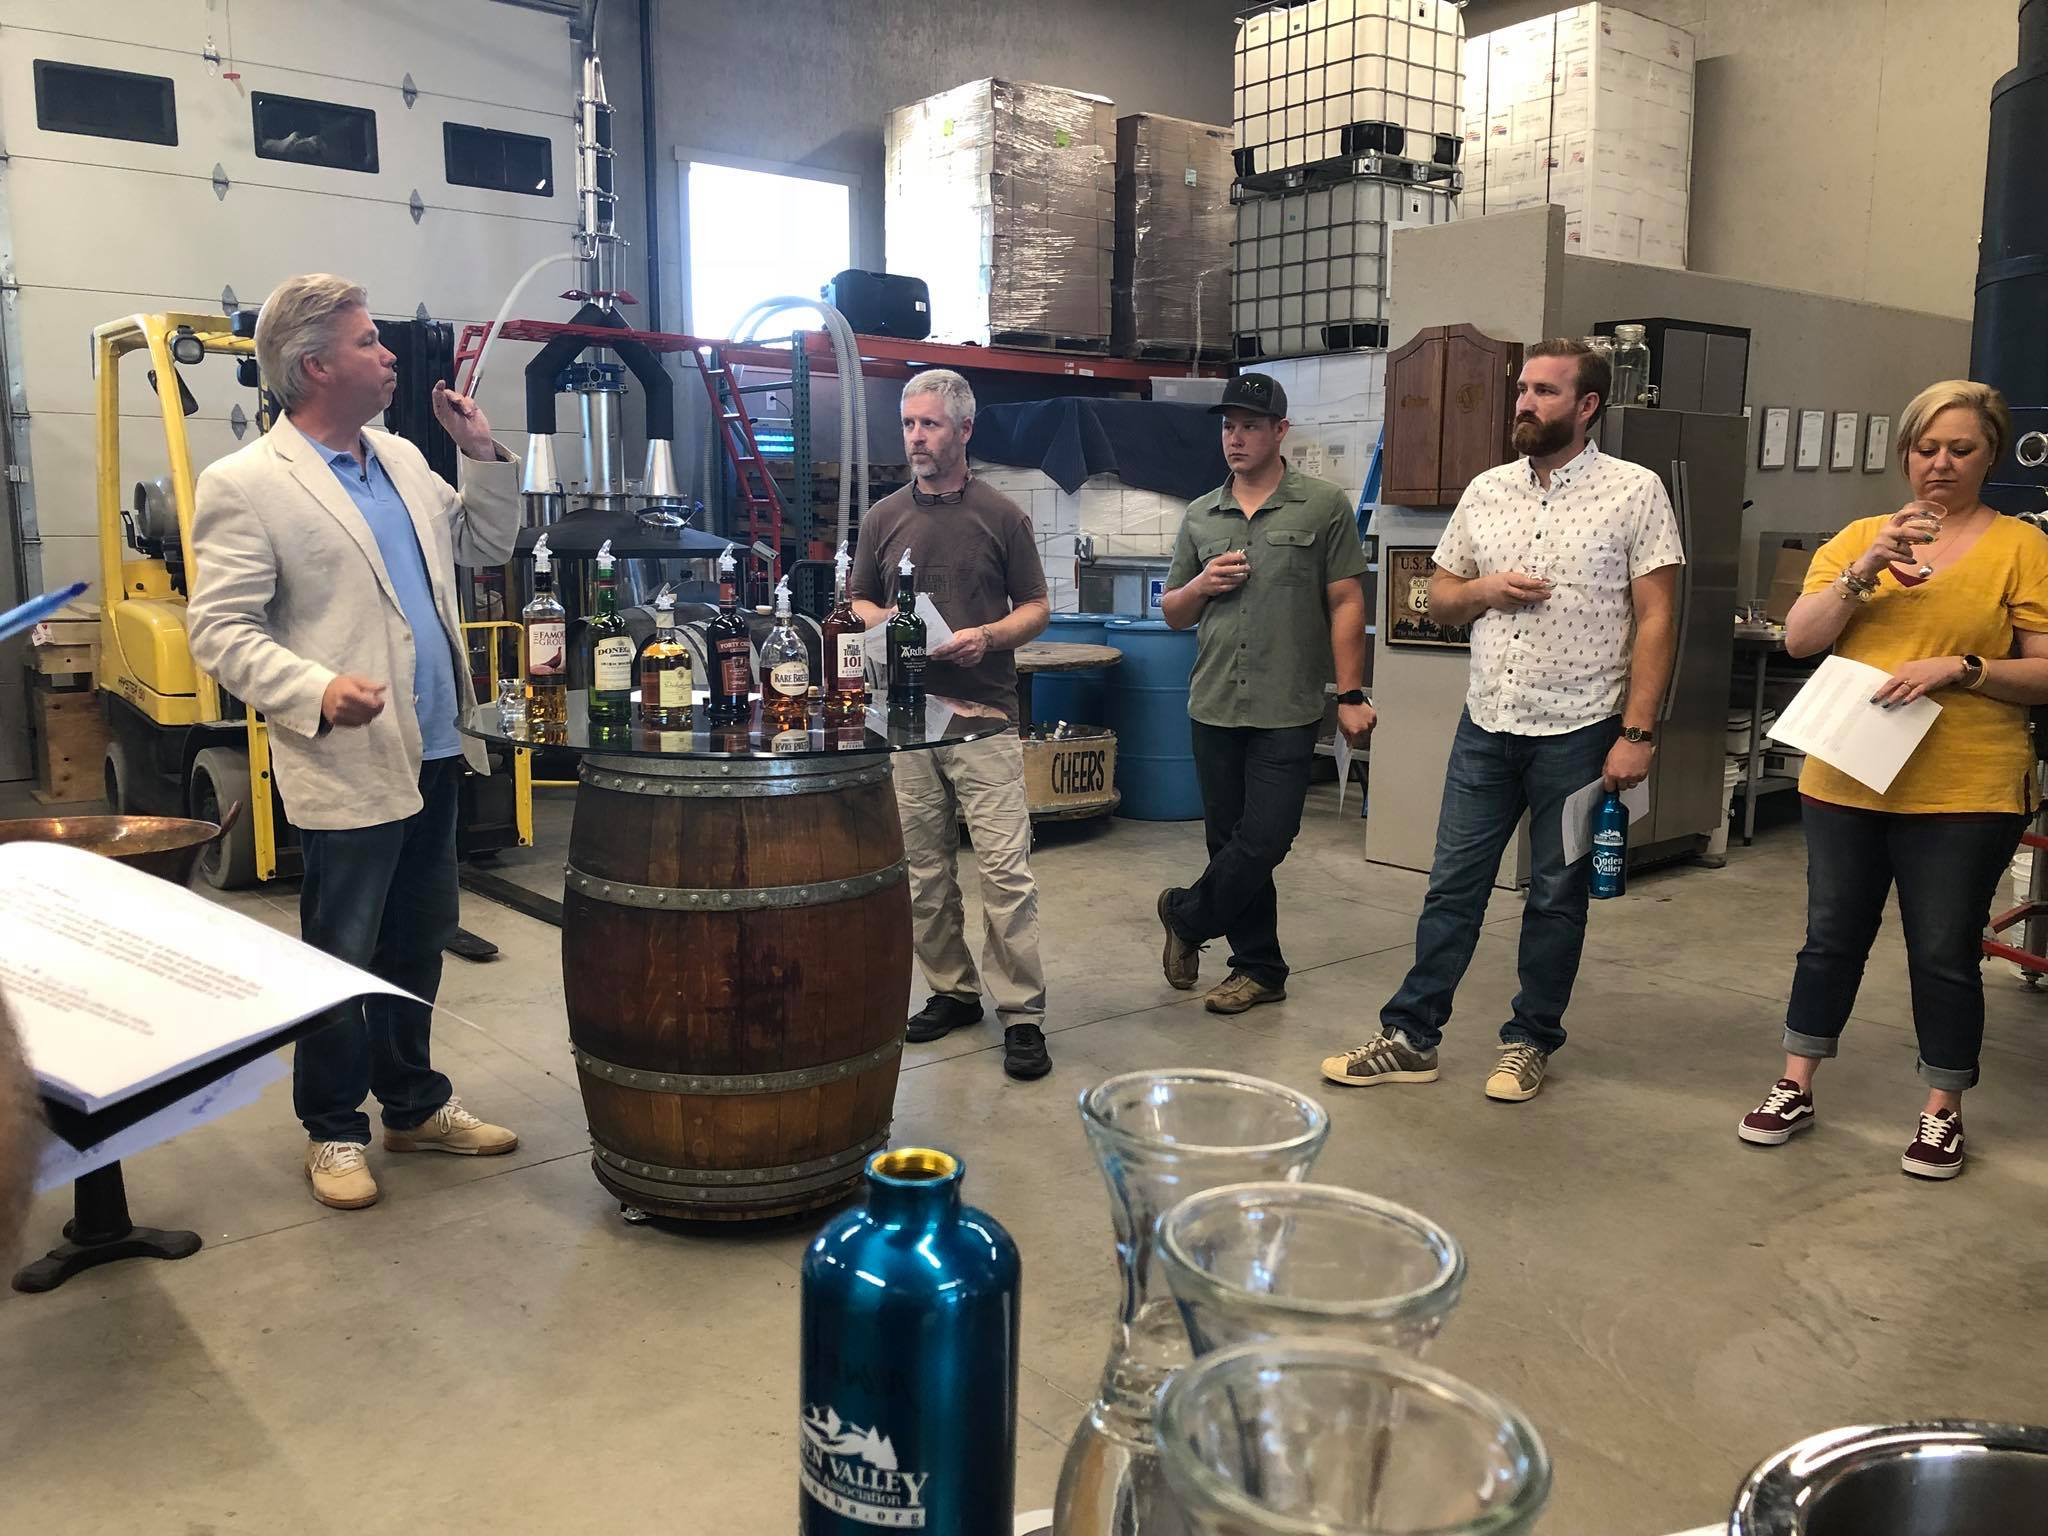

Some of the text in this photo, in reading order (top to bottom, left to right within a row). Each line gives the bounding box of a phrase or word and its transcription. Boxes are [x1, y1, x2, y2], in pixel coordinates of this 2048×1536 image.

[1401, 557, 1422, 571] U.S.
[843, 656, 861, 668] 101
[774, 673, 792, 683] RARE
[1051, 750, 1105, 794] CHEERS
[1593, 855, 1623, 869] Ogden
[1595, 864, 1621, 875] Valley
[829, 1455, 930, 1507] VALLEY
